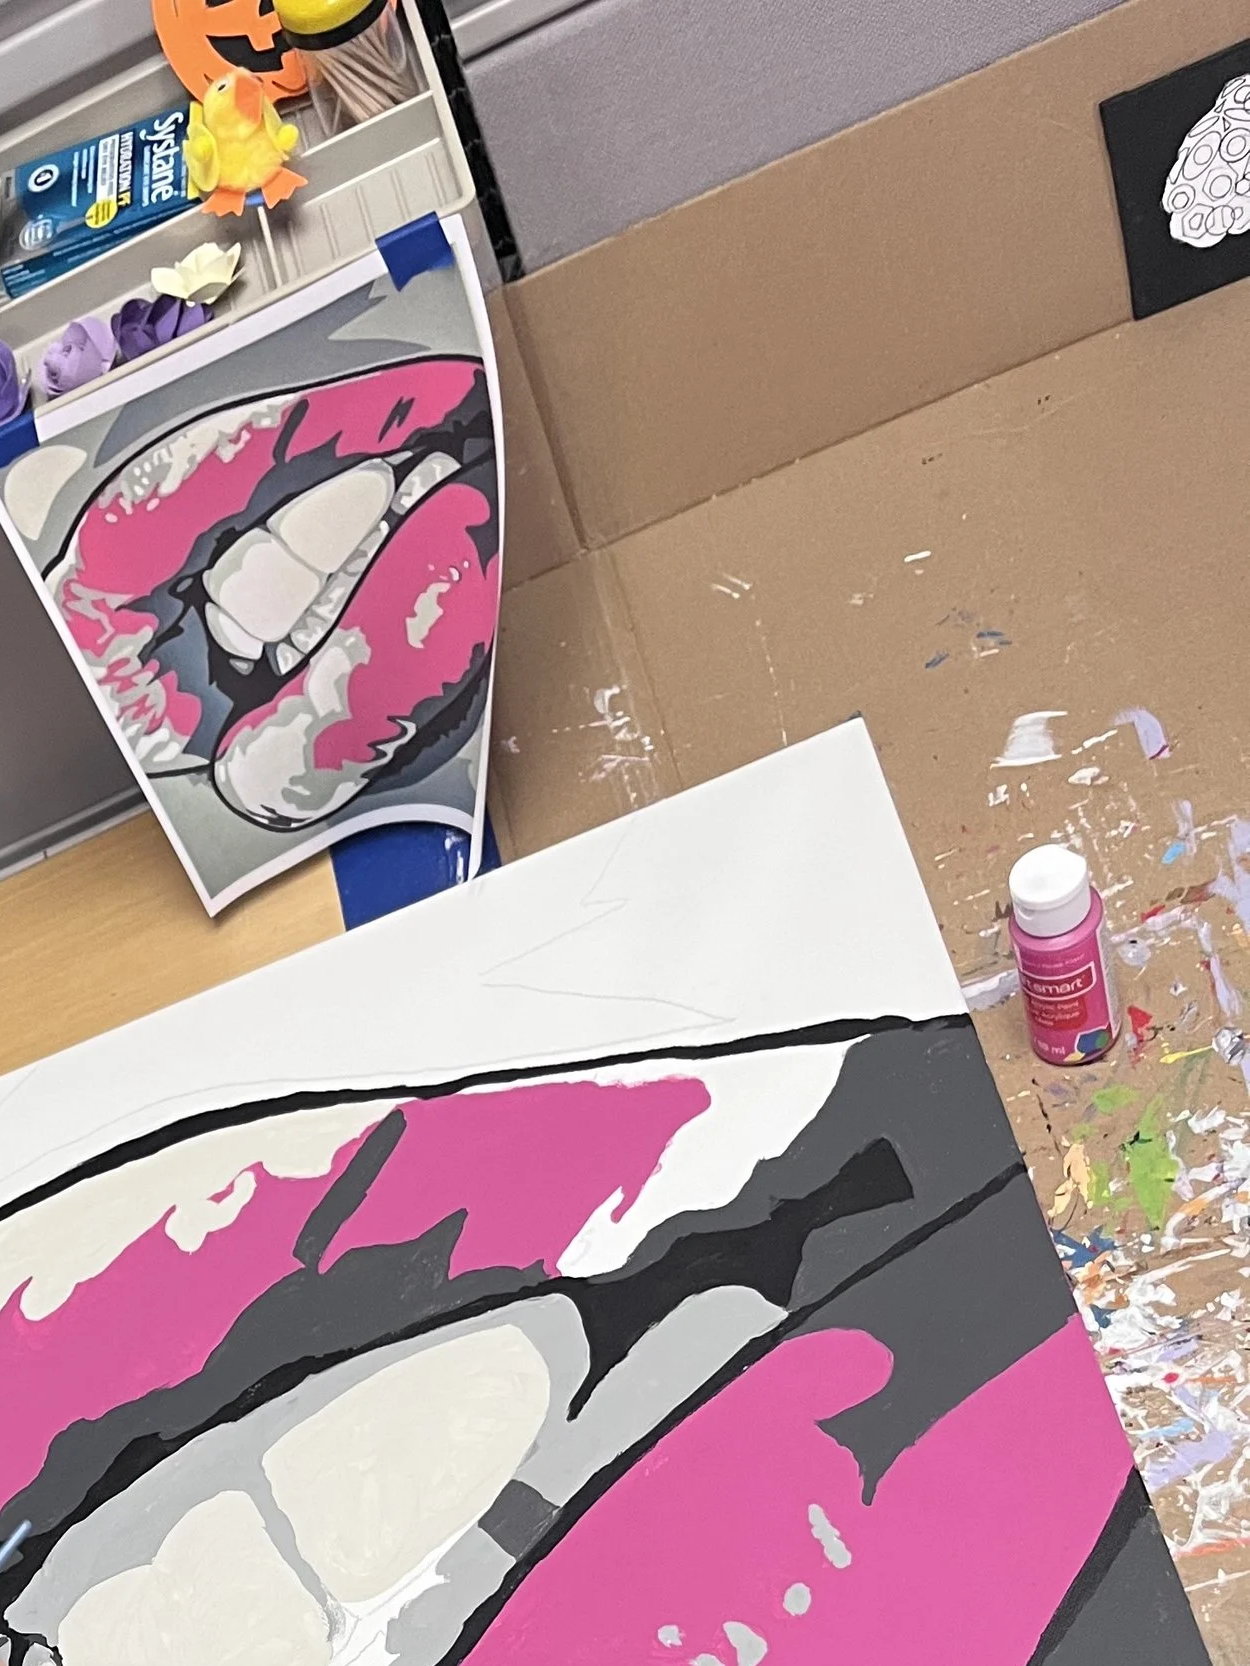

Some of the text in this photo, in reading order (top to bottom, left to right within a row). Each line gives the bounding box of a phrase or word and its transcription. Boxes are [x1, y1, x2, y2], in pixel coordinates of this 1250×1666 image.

[118, 131, 134, 193] HYDRATION
[140, 111, 184, 204] Systane
[1020, 975, 1083, 995] tsmart
